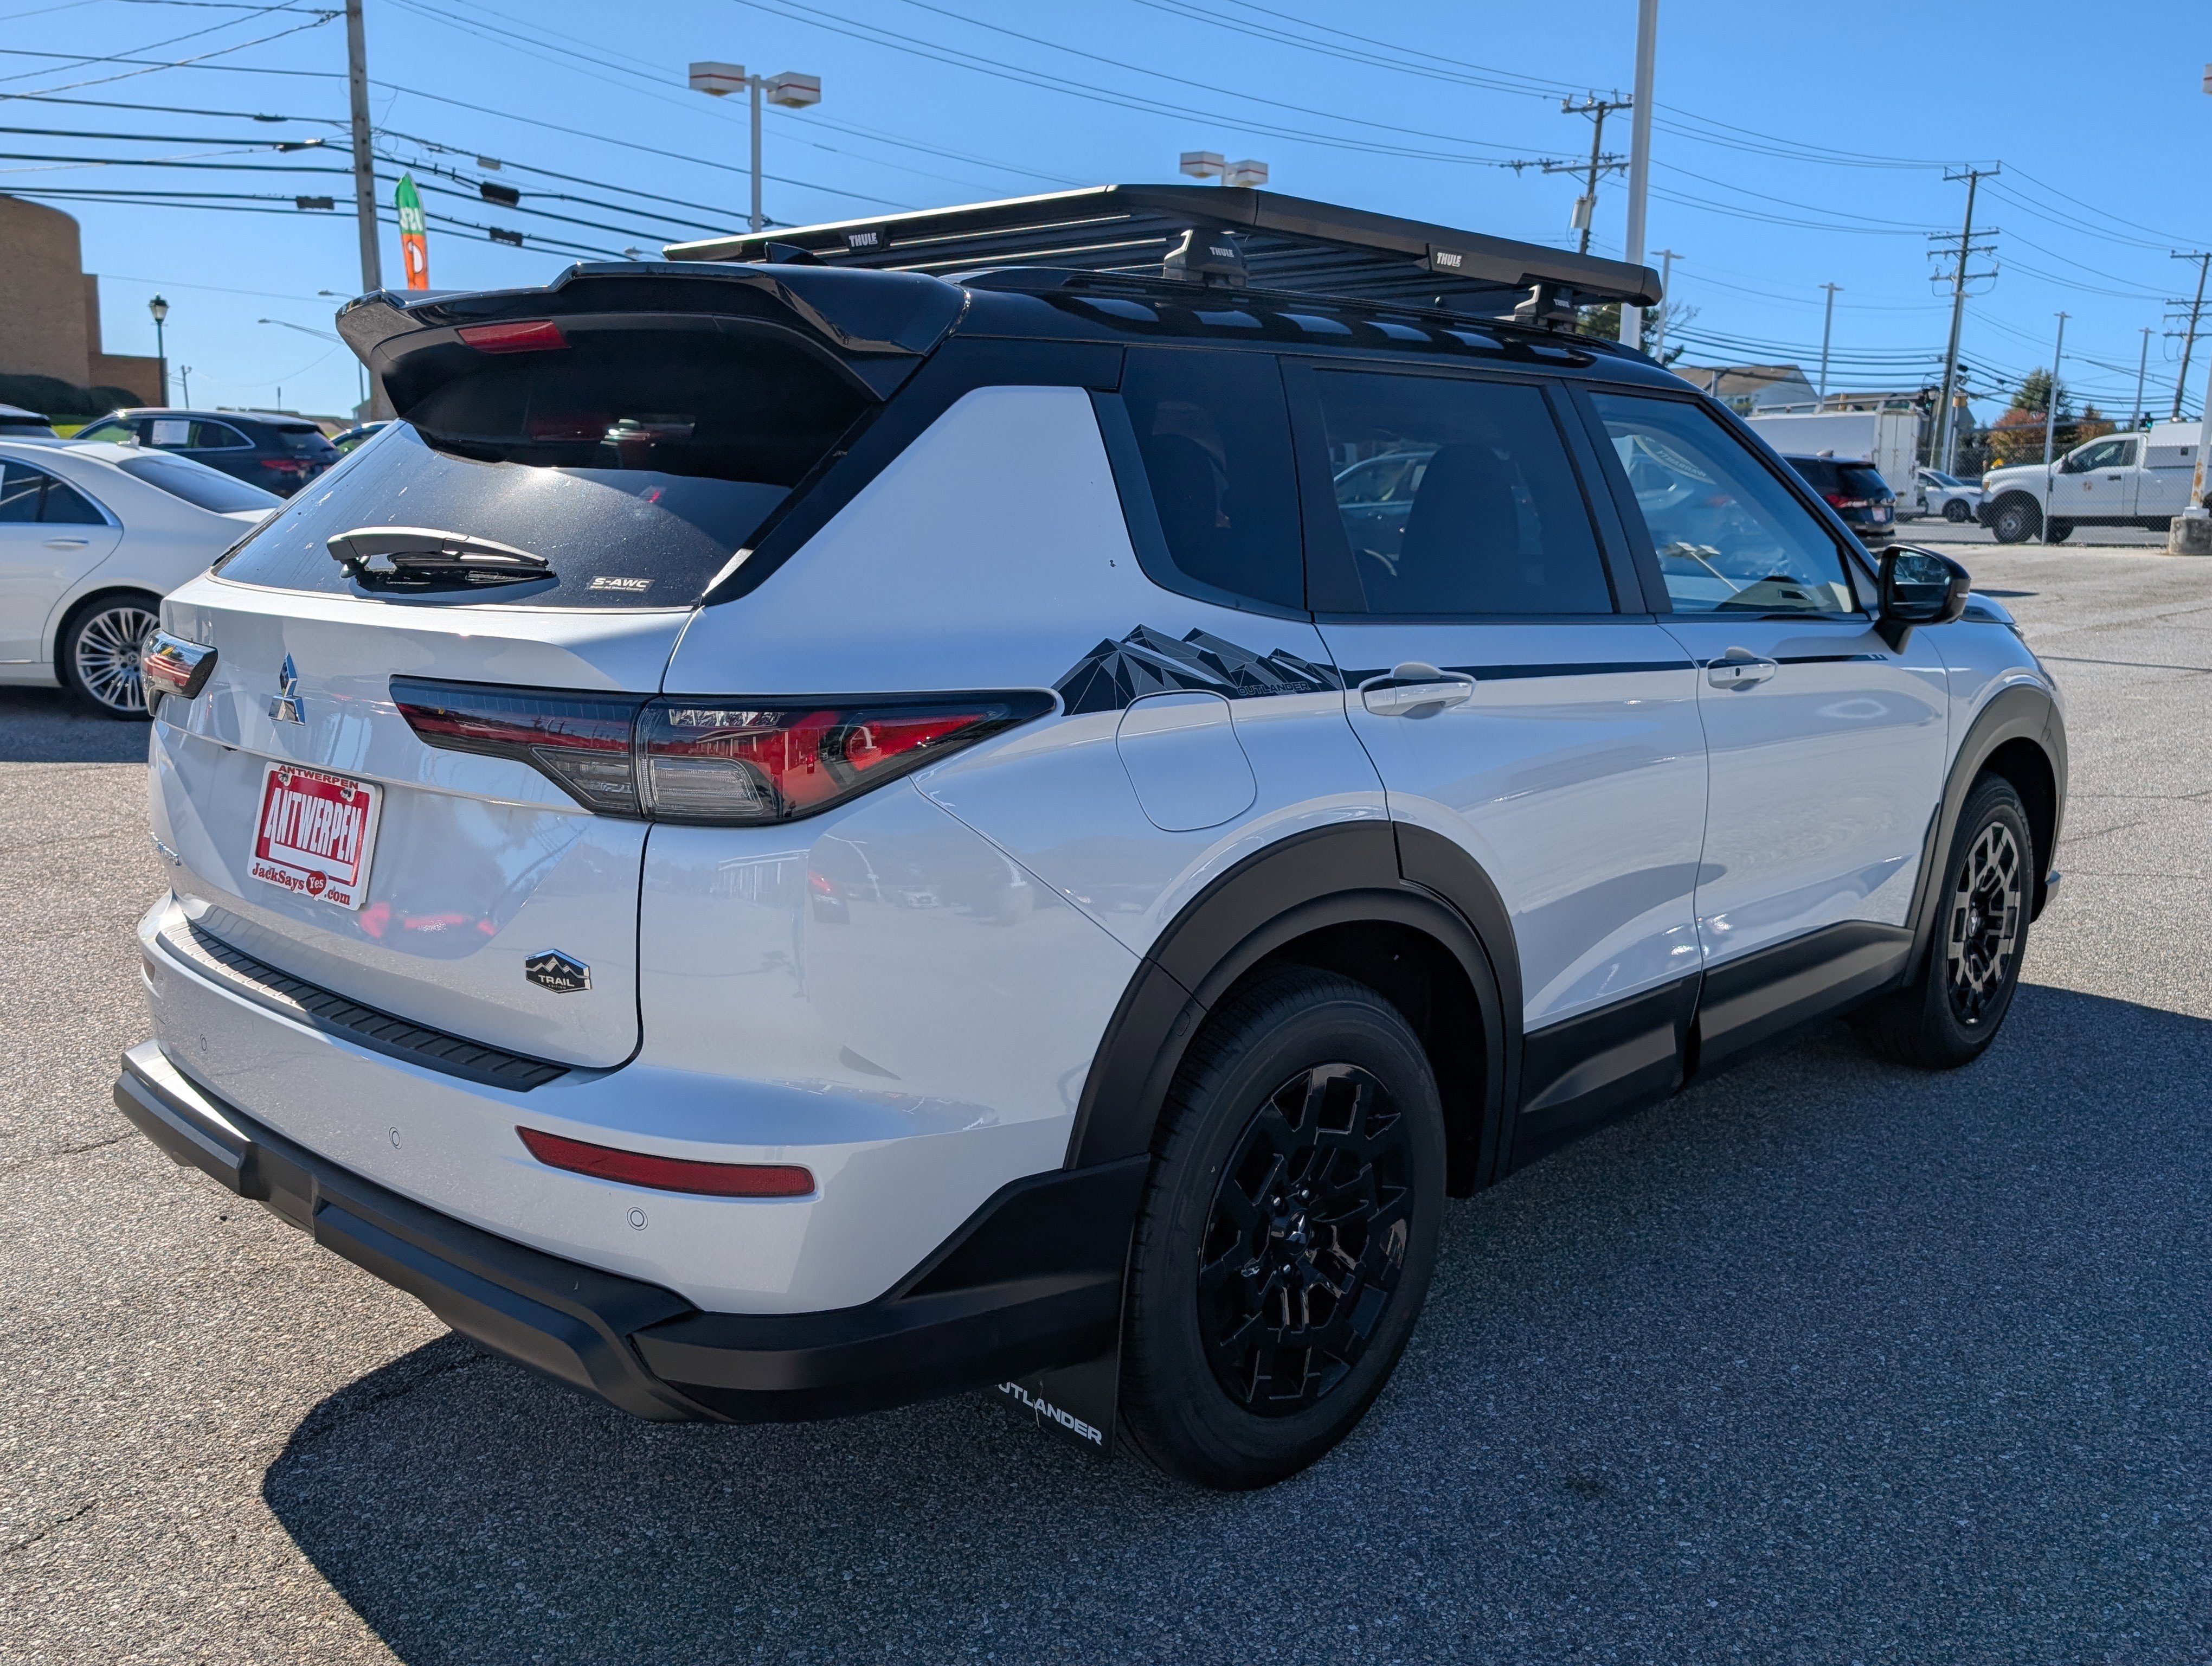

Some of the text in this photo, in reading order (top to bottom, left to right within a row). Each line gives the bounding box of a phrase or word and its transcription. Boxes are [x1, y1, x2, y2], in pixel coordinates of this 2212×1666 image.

[848, 232, 878, 247] THULE
[1209, 246, 1234, 258] THULE
[1437, 252, 1462, 267] THULE
[593, 578, 650, 588] S-AWC
[1237, 681, 1311, 696] OUTLANDER
[279, 765, 359, 790] ANTWERPEN
[263, 787, 362, 863] ANTWERPEN
[538, 975, 575, 987] TRAIL
[998, 1381, 1102, 1446] UTLANDER
